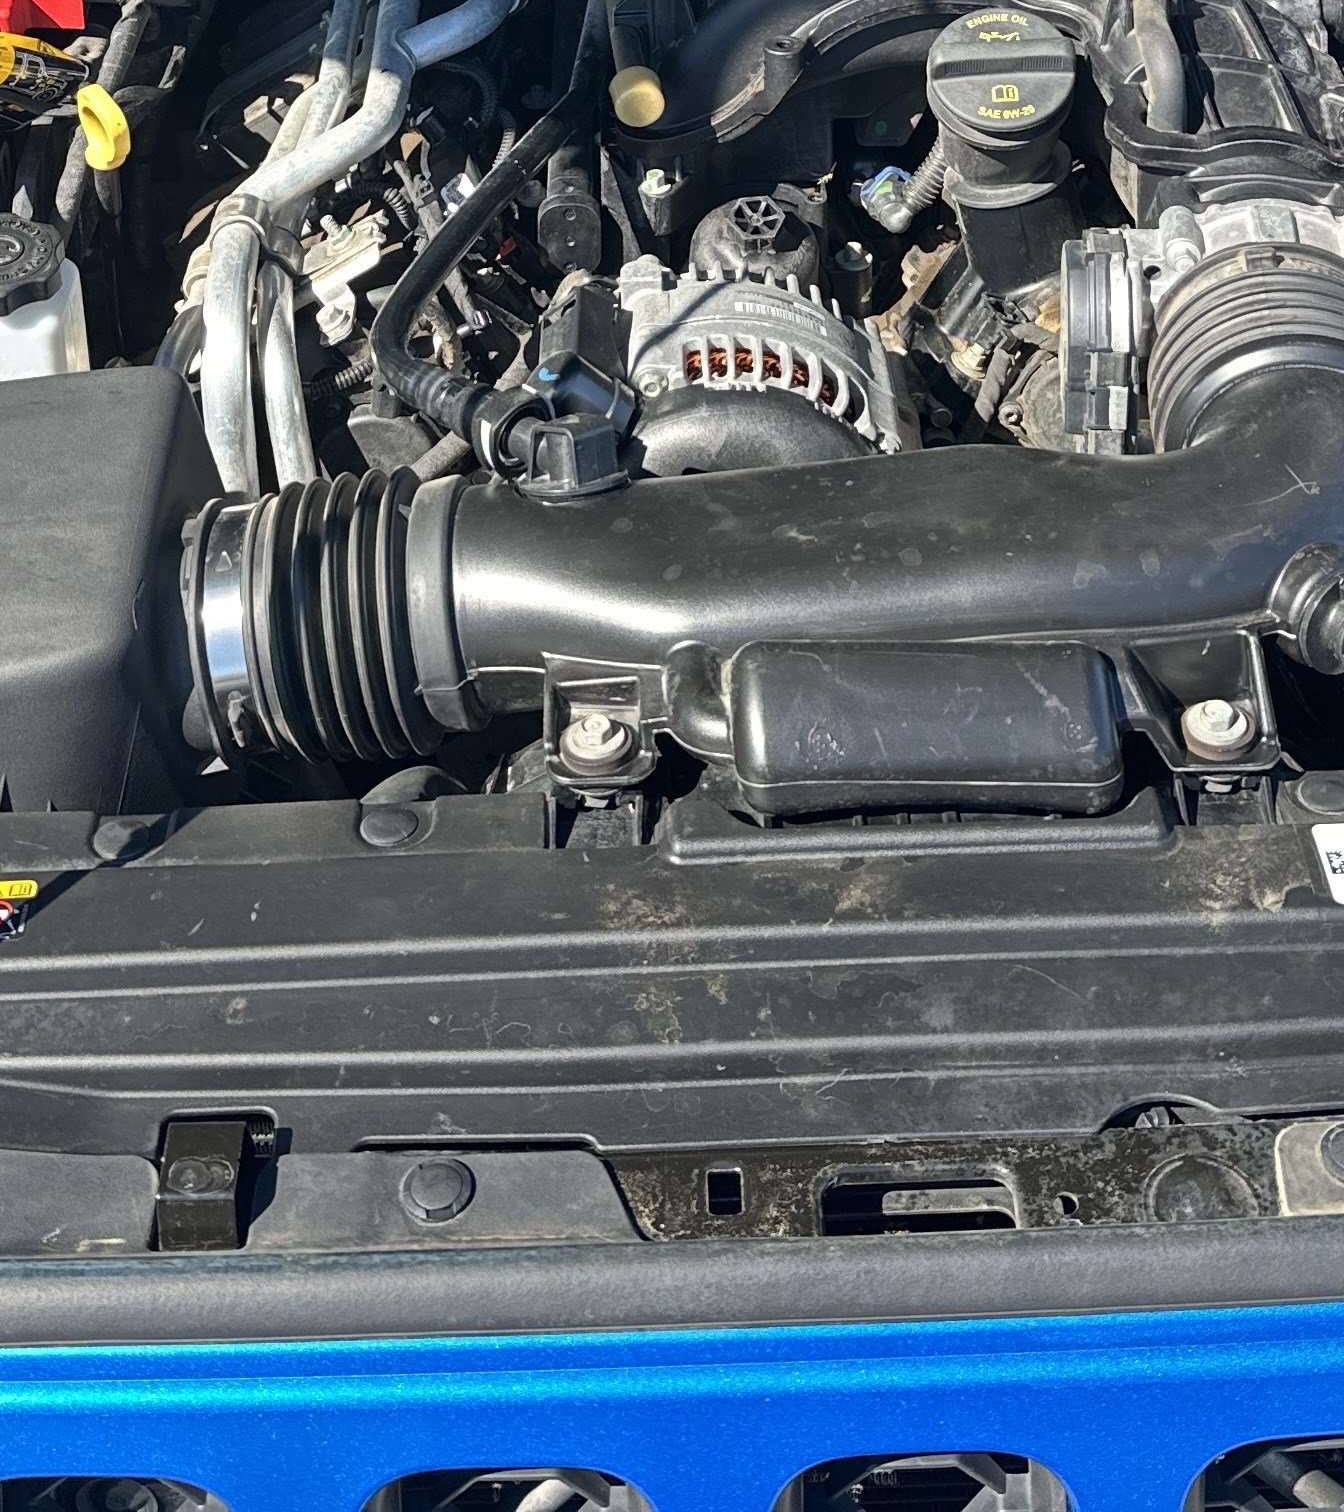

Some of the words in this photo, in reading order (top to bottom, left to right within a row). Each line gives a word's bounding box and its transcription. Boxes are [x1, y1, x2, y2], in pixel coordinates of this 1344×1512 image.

[965, 13, 1008, 29] ENGINE
[1011, 14, 1029, 28] OIL
[978, 106, 1001, 119] SAE
